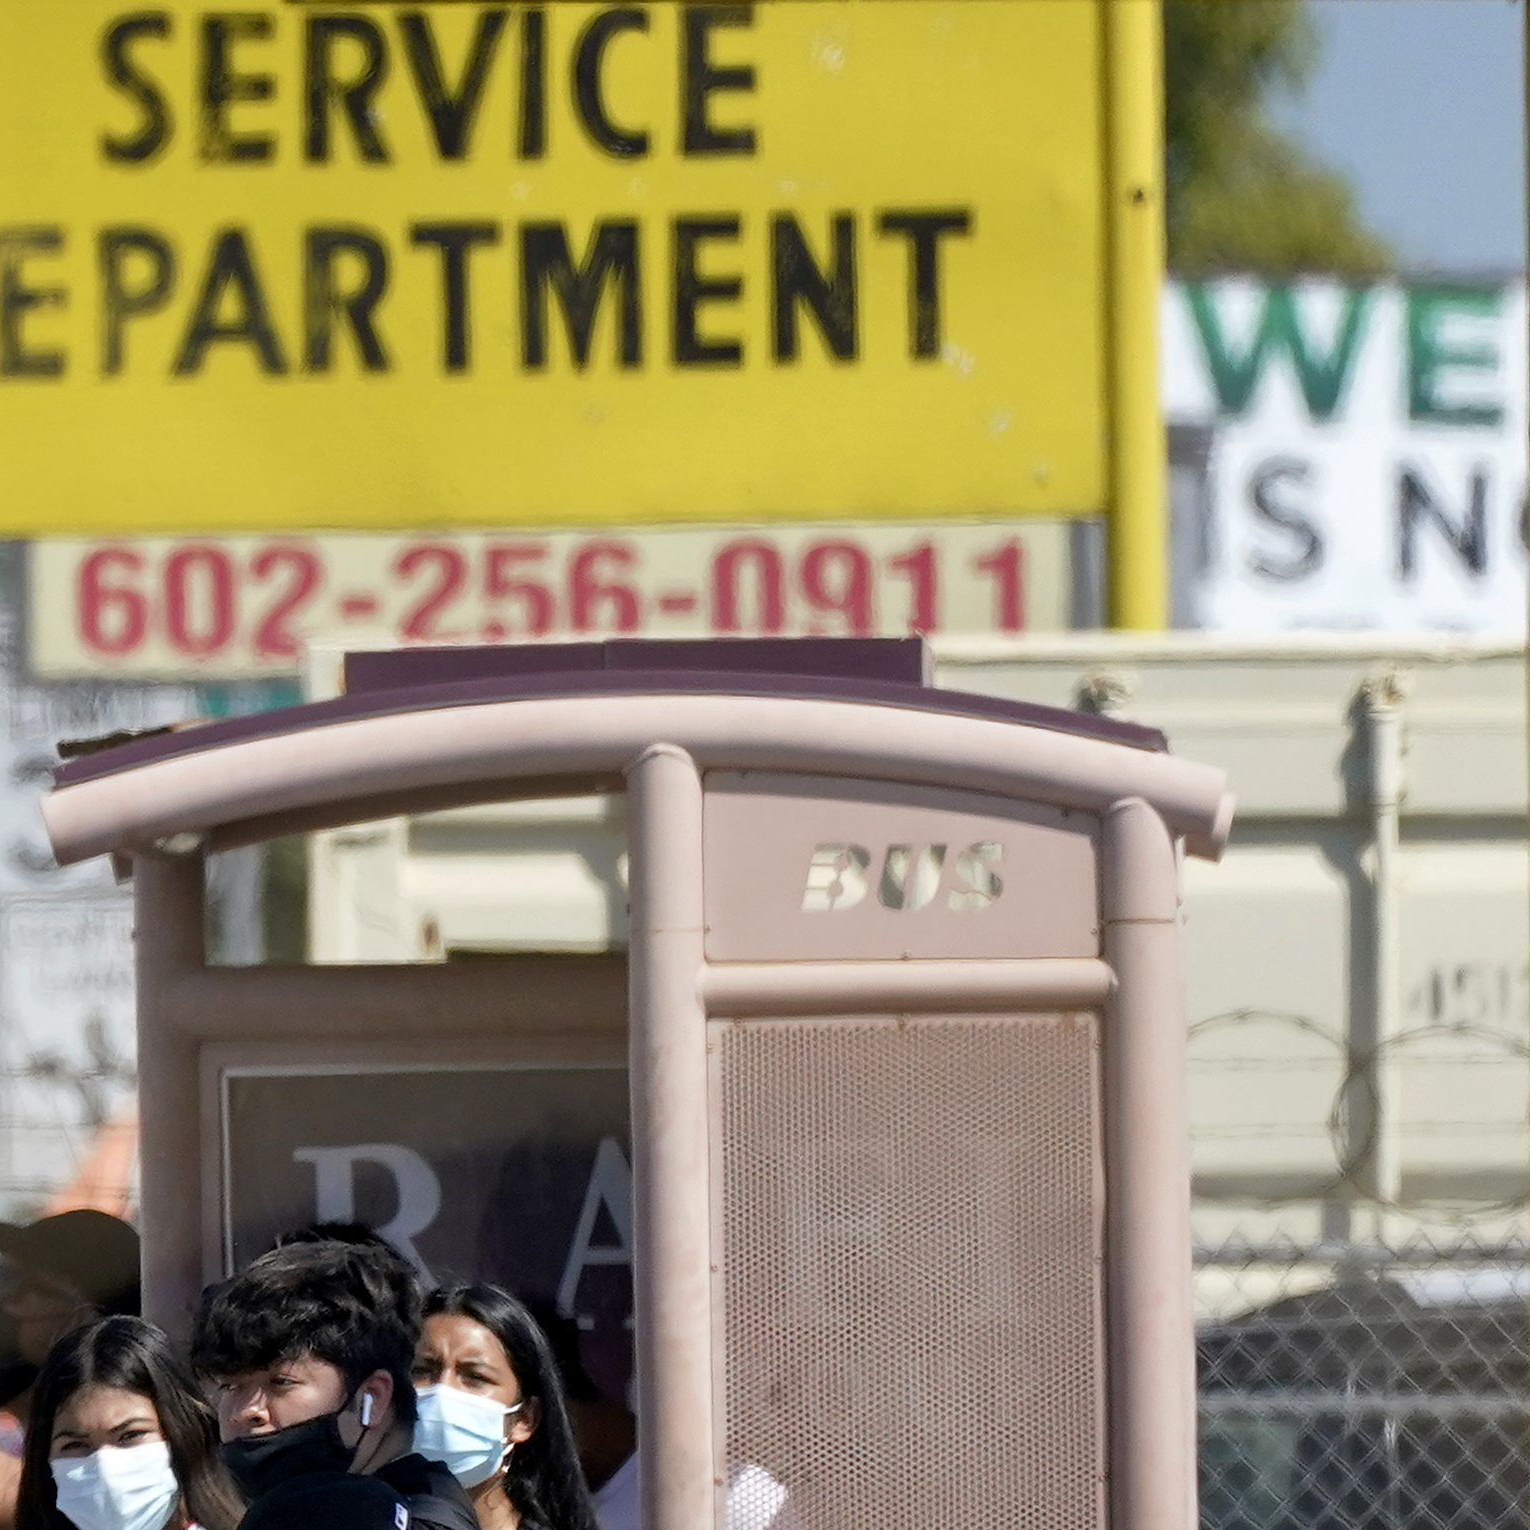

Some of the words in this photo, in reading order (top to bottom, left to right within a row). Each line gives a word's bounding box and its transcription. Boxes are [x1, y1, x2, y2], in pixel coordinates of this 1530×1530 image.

[96, 4, 759, 168] SERVICE
[72, 536, 1028, 660] 602-256-0911
[801, 841, 1005, 912] BUS
